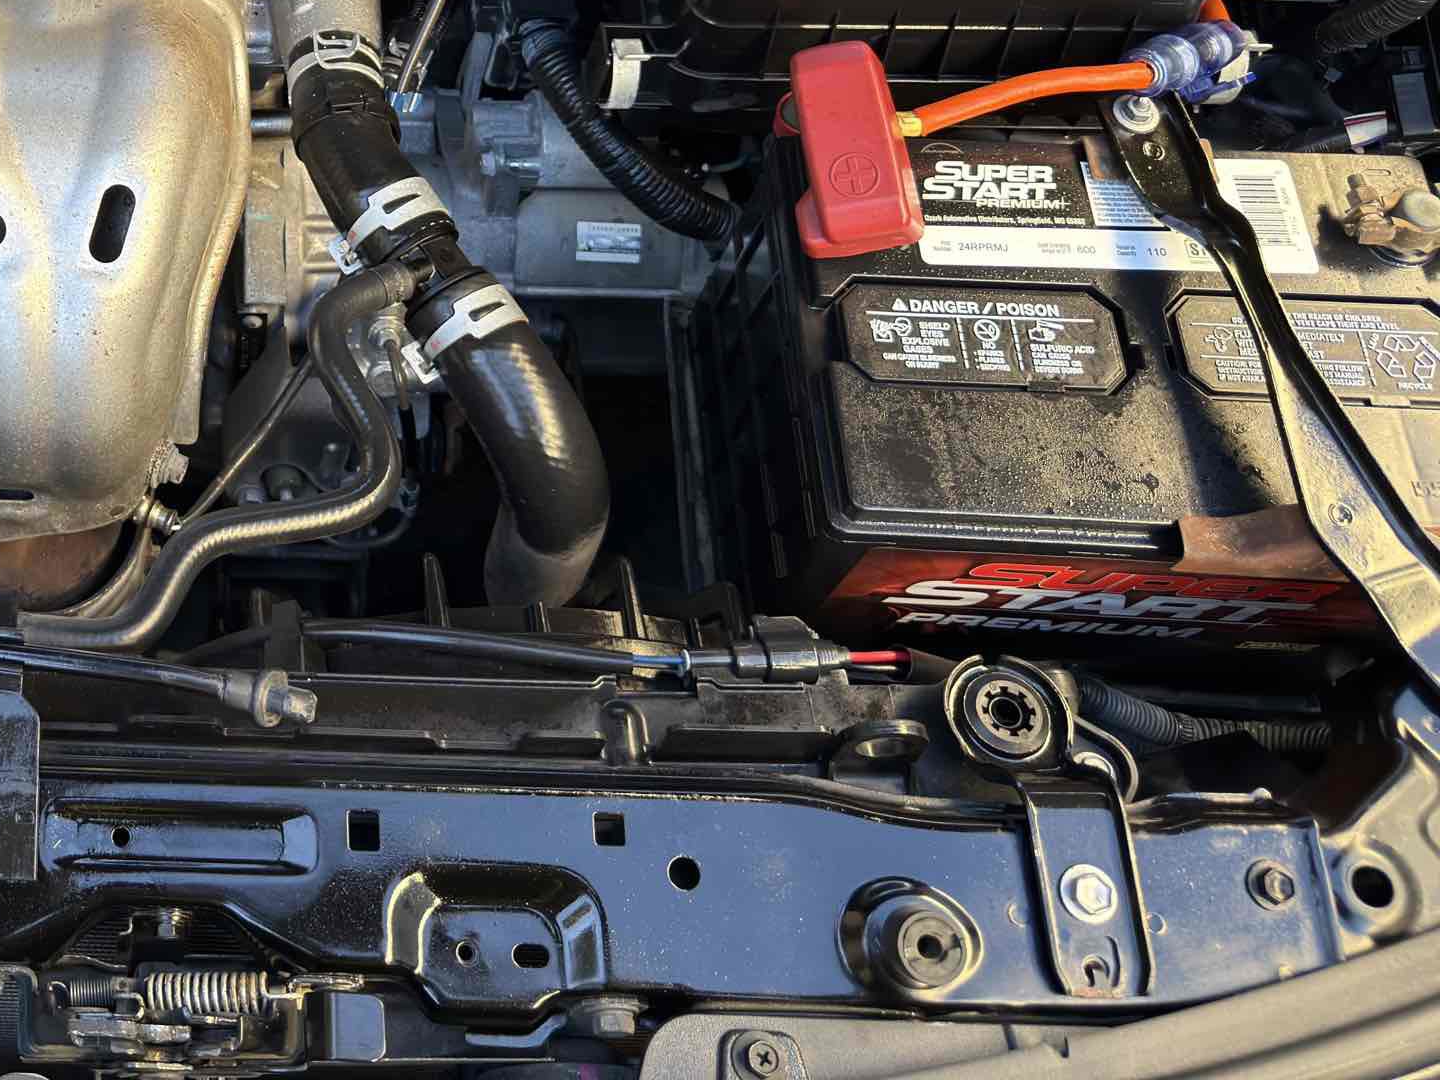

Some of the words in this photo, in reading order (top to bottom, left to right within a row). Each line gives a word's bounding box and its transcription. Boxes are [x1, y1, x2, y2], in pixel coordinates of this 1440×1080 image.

[935, 160, 1053, 183] SUPER
[922, 177, 1057, 201] START
[1147, 247, 1168, 257] 110
[909, 299, 980, 315] DANGER
[996, 302, 1060, 317] POISON
[919, 322, 951, 330] SHIELD
[920, 330, 945, 338] EYES
[902, 337, 951, 347] EXPLOSIVE
[982, 341, 996, 349] NO
[903, 345, 934, 354] GASES
[1030, 344, 1074, 354] SULFURIC
[1075, 345, 1095, 354] ACID
[954, 562, 1341, 604] SUPER
[881, 580, 1314, 621] START
[894, 611, 1206, 639] PREMIUM
